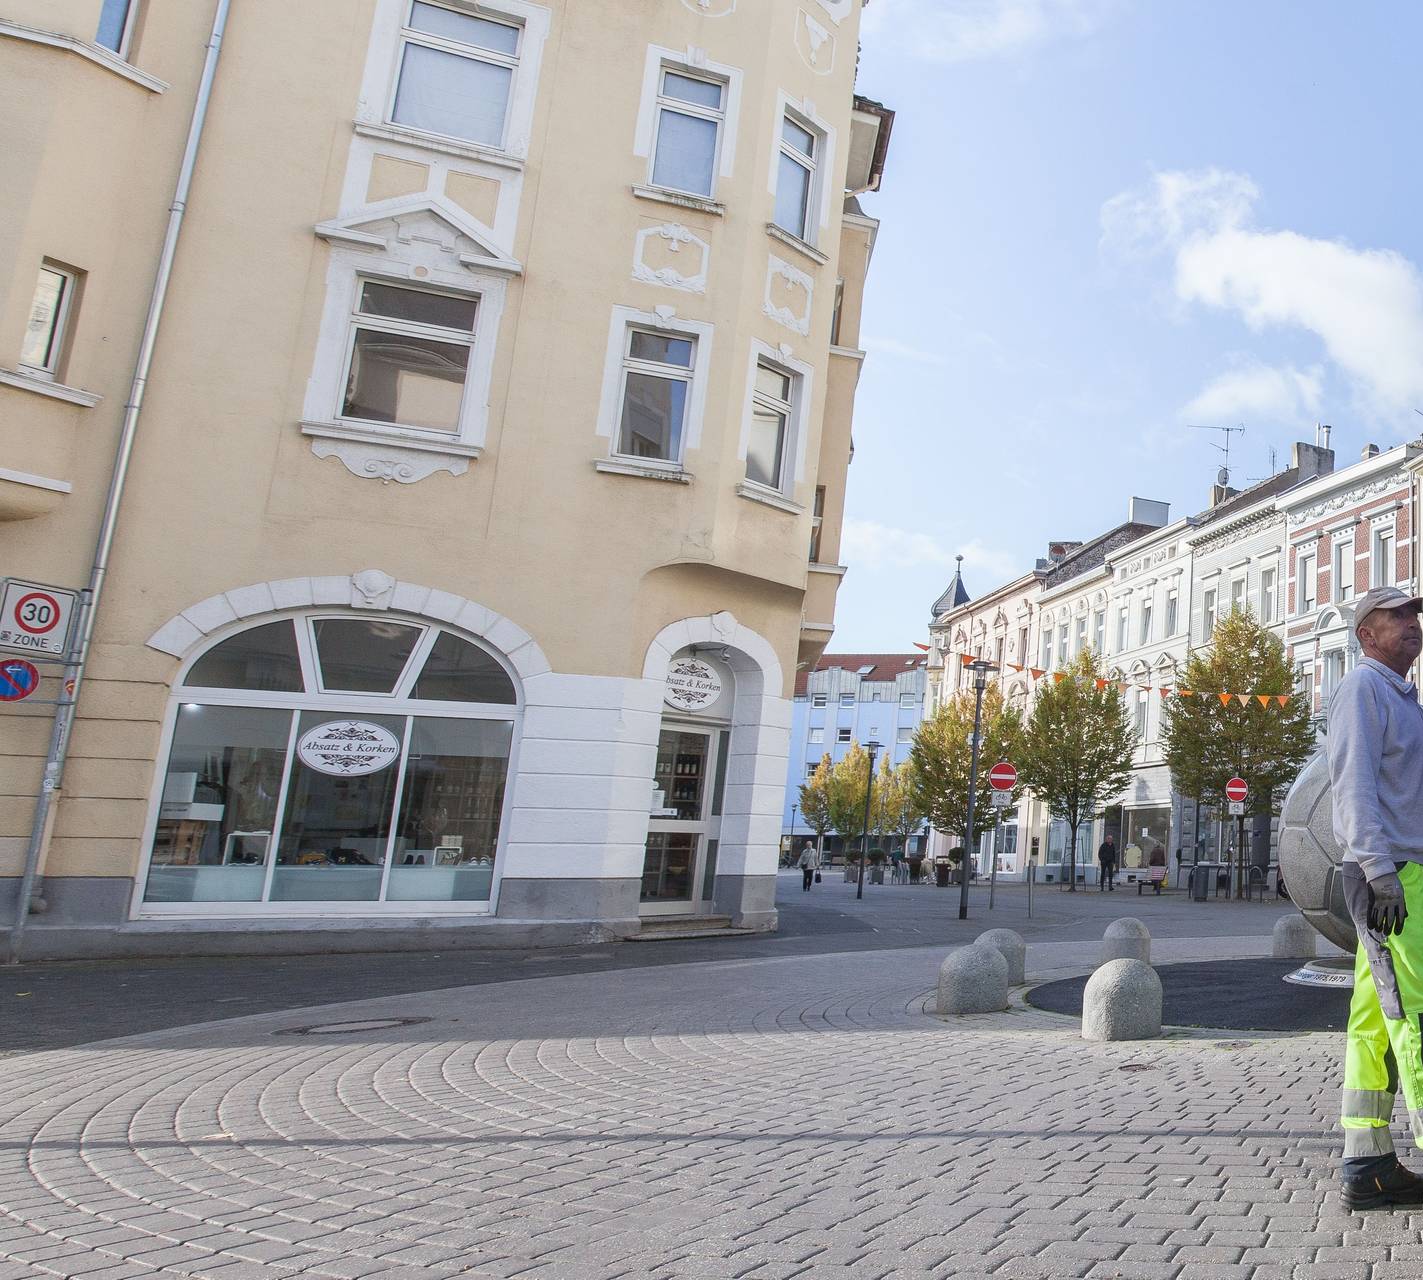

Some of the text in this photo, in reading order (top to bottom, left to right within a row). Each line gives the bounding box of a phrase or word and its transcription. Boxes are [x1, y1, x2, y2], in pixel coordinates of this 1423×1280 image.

[23, 603, 51, 623] 30
[13, 634, 49, 649] ZONE
[666, 675, 686, 686] bsatz
[696, 680, 720, 691] Korken
[303, 741, 395, 753] Absatz & Korken
